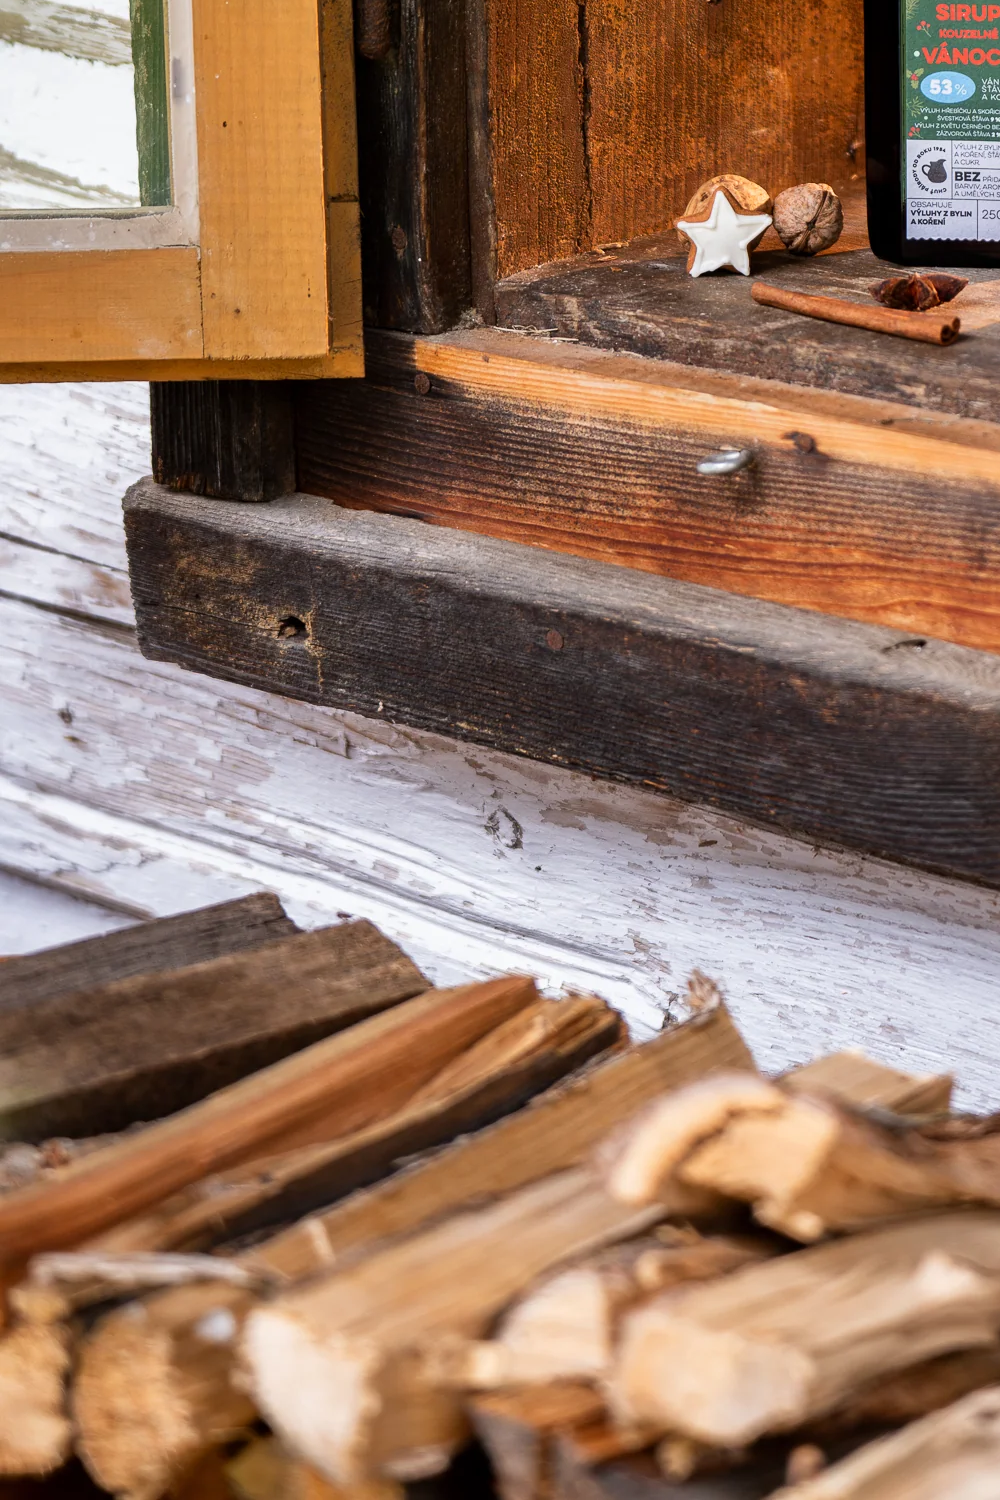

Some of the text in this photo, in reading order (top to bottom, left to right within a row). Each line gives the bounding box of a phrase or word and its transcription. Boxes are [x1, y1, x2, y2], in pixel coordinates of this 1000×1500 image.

[939, 27, 999, 39] KOUZELNÉ
[929, 79, 966, 95] 53 %
[937, 114, 971, 122] ŠVESTKOVÁ
[936, 130, 972, 138] ZÁZVOROVÁ
[913, 159, 918, 168] OD
[917, 147, 932, 159] ROKU
[954, 172, 980, 182] BEZ
[961, 190, 995, 198] UMĚLÝCH
[910, 208, 942, 217] VÝLUHY
[917, 217, 946, 225] KOŘENÍ
